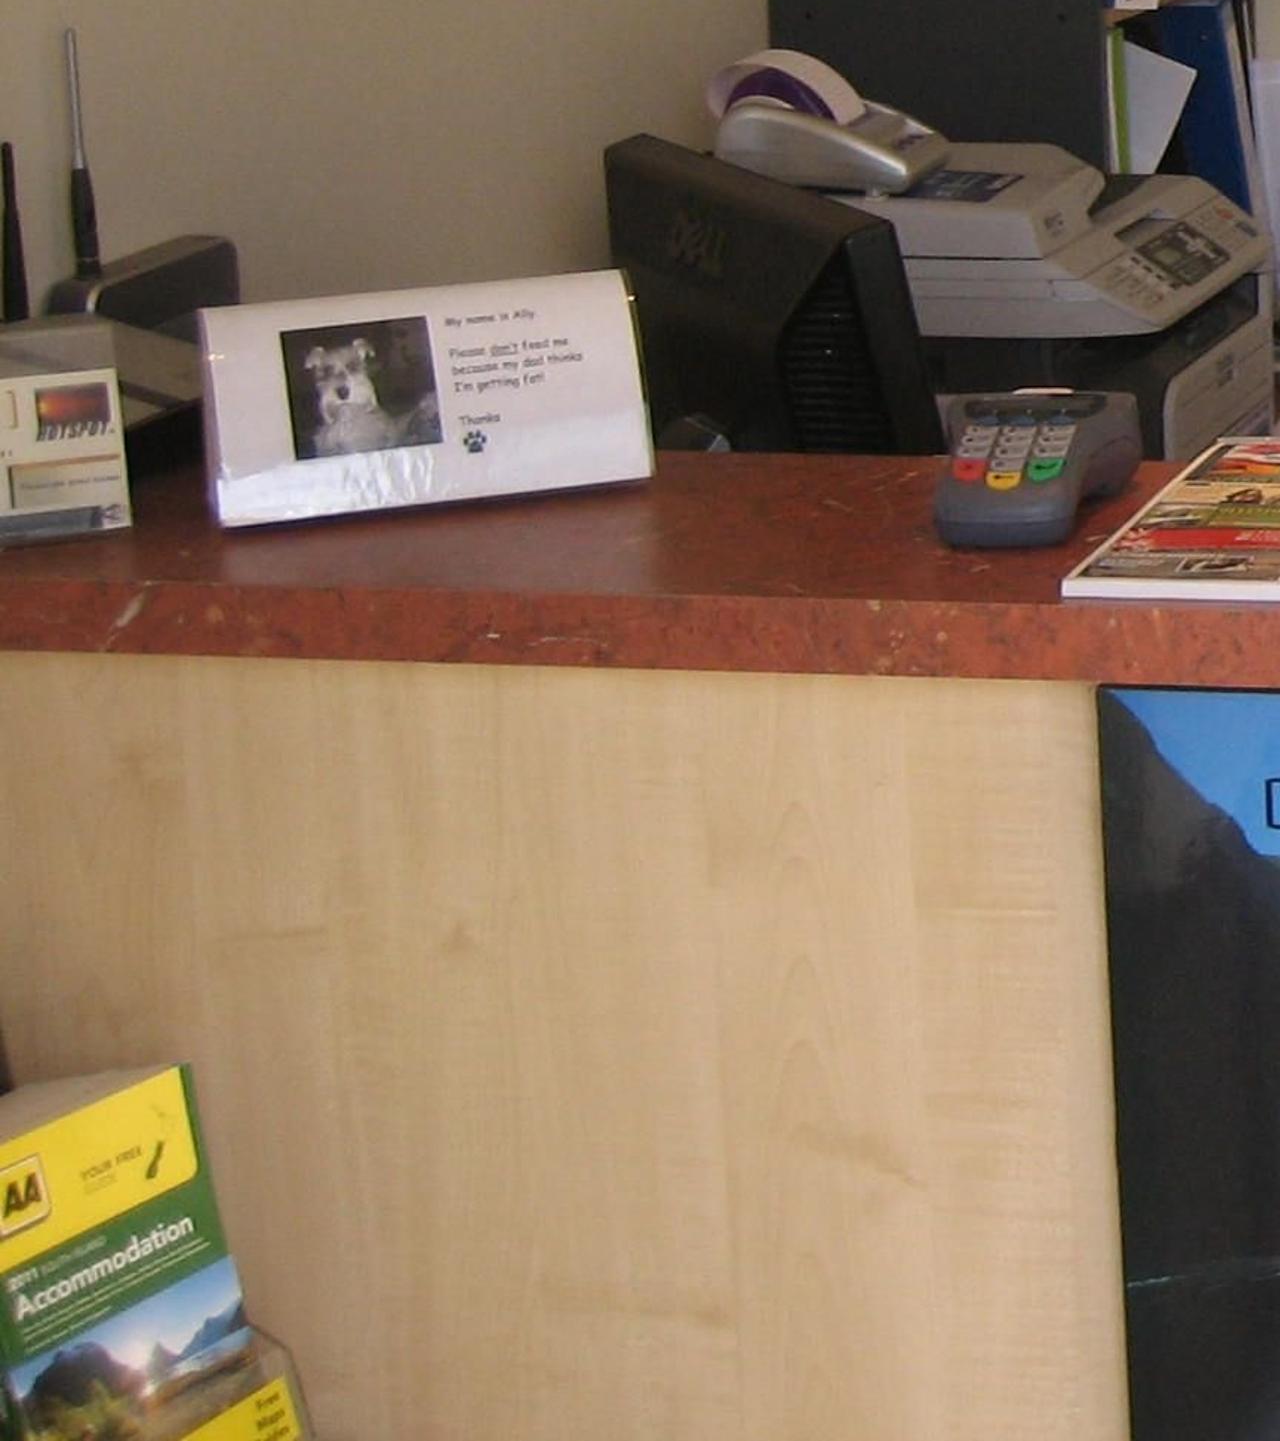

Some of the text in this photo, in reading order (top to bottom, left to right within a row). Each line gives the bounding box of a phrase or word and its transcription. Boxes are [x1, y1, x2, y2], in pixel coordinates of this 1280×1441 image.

[522, 338, 549, 350] feed
[553, 337, 568, 346] me
[452, 362, 499, 376] because
[502, 360, 518, 371] my
[459, 412, 501, 426] Thanks
[3, 1170, 42, 1219] AA
[16, 1215, 196, 1322] Accommodation
